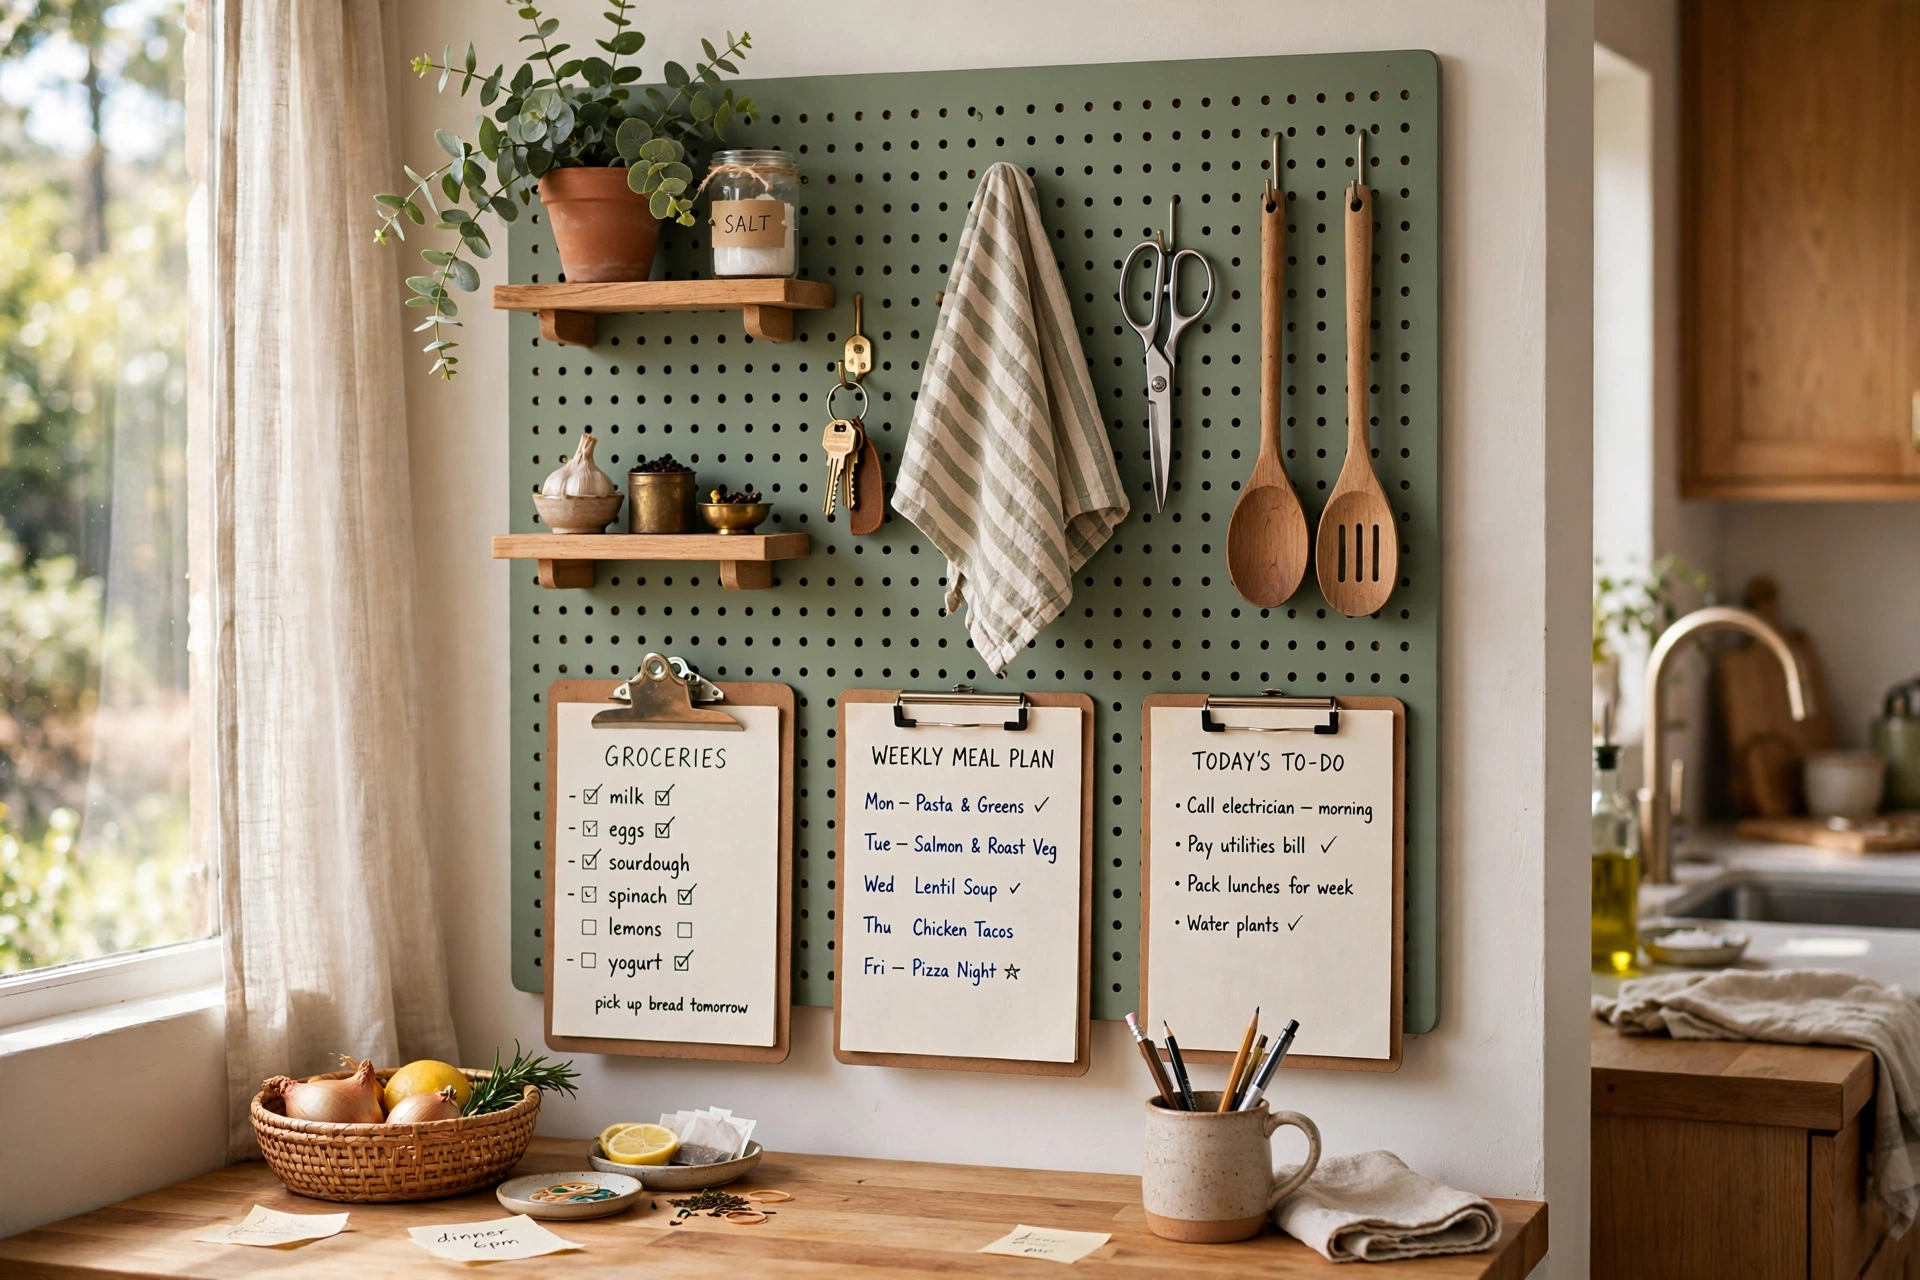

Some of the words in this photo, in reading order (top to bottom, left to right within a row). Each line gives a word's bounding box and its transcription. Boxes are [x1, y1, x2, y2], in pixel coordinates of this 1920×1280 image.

[725, 215, 771, 233] SALT
[605, 745, 726, 768] GROCERIES
[872, 745, 943, 766] WEEKLY
[953, 747, 1000, 767] MEAL
[1010, 748, 1054, 768] PLAN
[1192, 750, 1270, 771] TODAY'S
[1282, 752, 1344, 772] TO-DO
[610, 786, 644, 804] milk
[865, 792, 894, 810] Mon
[917, 793, 953, 812] Pasta
[961, 798, 970, 812] &
[978, 796, 1024, 813] Greens
[1188, 796, 1214, 813] Call
[1222, 797, 1294, 814] electrician
[1319, 802, 1372, 824] morning
[609, 825, 644, 845] eggs
[864, 833, 891, 851] Tue
[914, 835, 962, 853] Salmon
[972, 838, 980, 853] &
[989, 837, 1025, 854] Roast
[1033, 838, 1056, 864] Veg
[1189, 835, 1213, 860] Pay
[1221, 836, 1275, 853] utilities
[1284, 836, 1304, 853] bill
[609, 853, 689, 879] sourdough
[865, 875, 894, 892] Wed
[916, 876, 955, 894] Lentil
[964, 878, 997, 902] Soup
[1188, 874, 1220, 892] Pack
[1229, 875, 1280, 894] lunches
[1289, 876, 1310, 894] for
[1317, 879, 1353, 895] week
[609, 886, 666, 909] spinach
[610, 917, 661, 937] lemons
[863, 916, 891, 933] Thu
[913, 918, 966, 936] Chicken
[974, 921, 1013, 938] Tacos
[1187, 915, 1229, 931] Water
[1237, 915, 1278, 938] plants
[608, 953, 662, 978] yogurt
[865, 957, 884, 974] Fri
[913, 958, 949, 977] Pizza
[957, 961, 997, 986] Night
[596, 994, 620, 1015] pick
[627, 1001, 642, 1016] up
[649, 995, 683, 1011] bread
[690, 998, 748, 1013] tomorrow
[437, 1229, 508, 1243] dinner
[474, 1240, 519, 1249] 6pm
